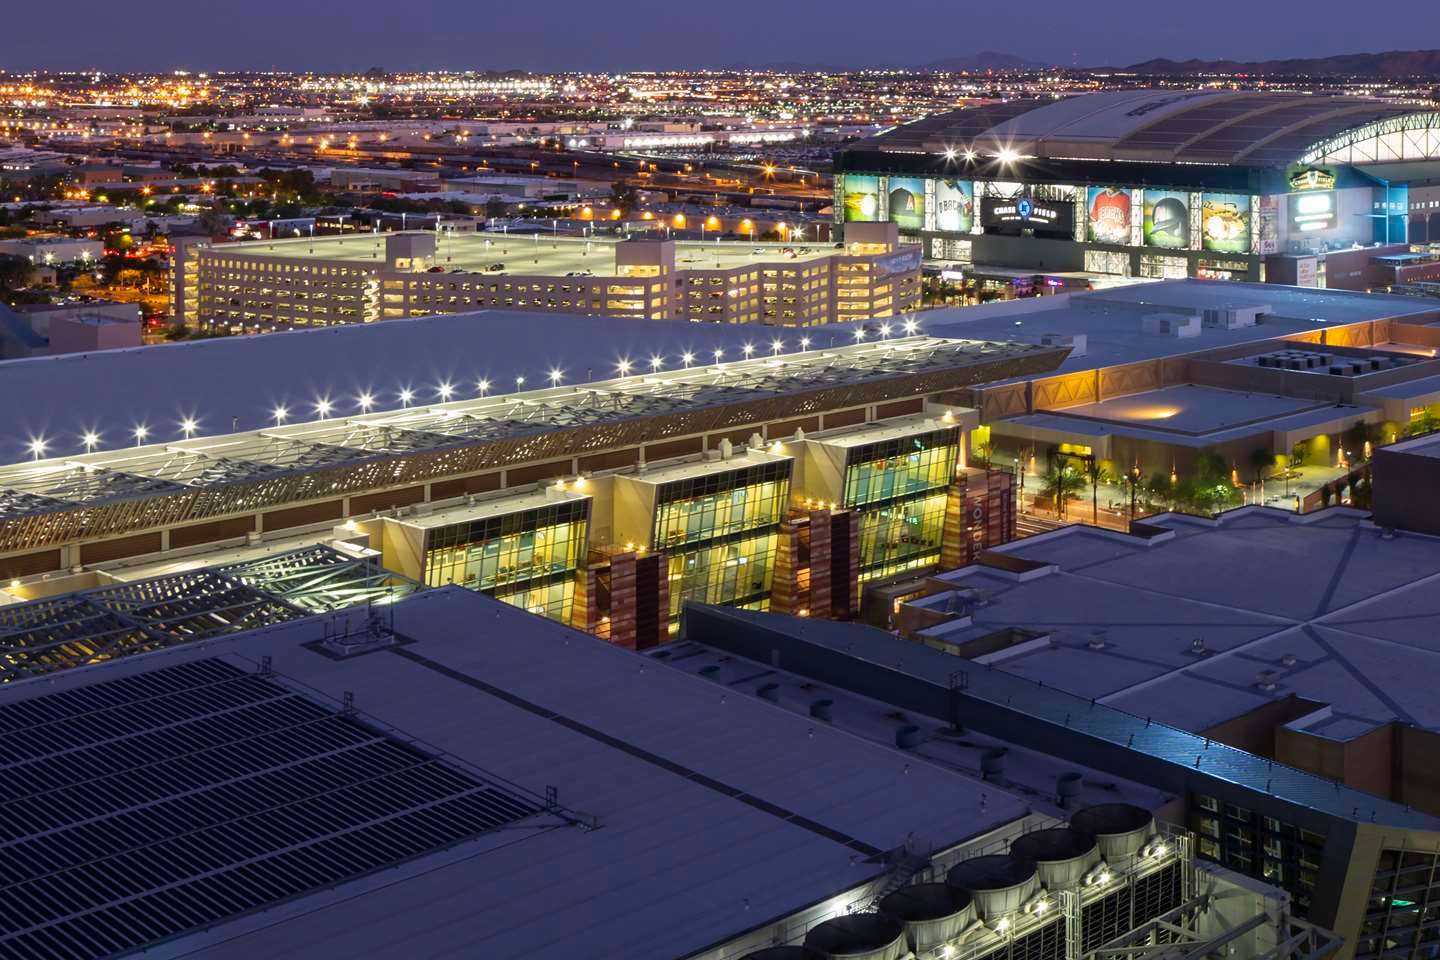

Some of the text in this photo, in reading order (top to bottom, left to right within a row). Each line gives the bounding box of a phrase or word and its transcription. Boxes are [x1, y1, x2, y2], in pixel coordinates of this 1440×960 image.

[993, 206, 1016, 215] CHASE
[1033, 207, 1056, 219] FIELD
[972, 496, 983, 560] WONDER
